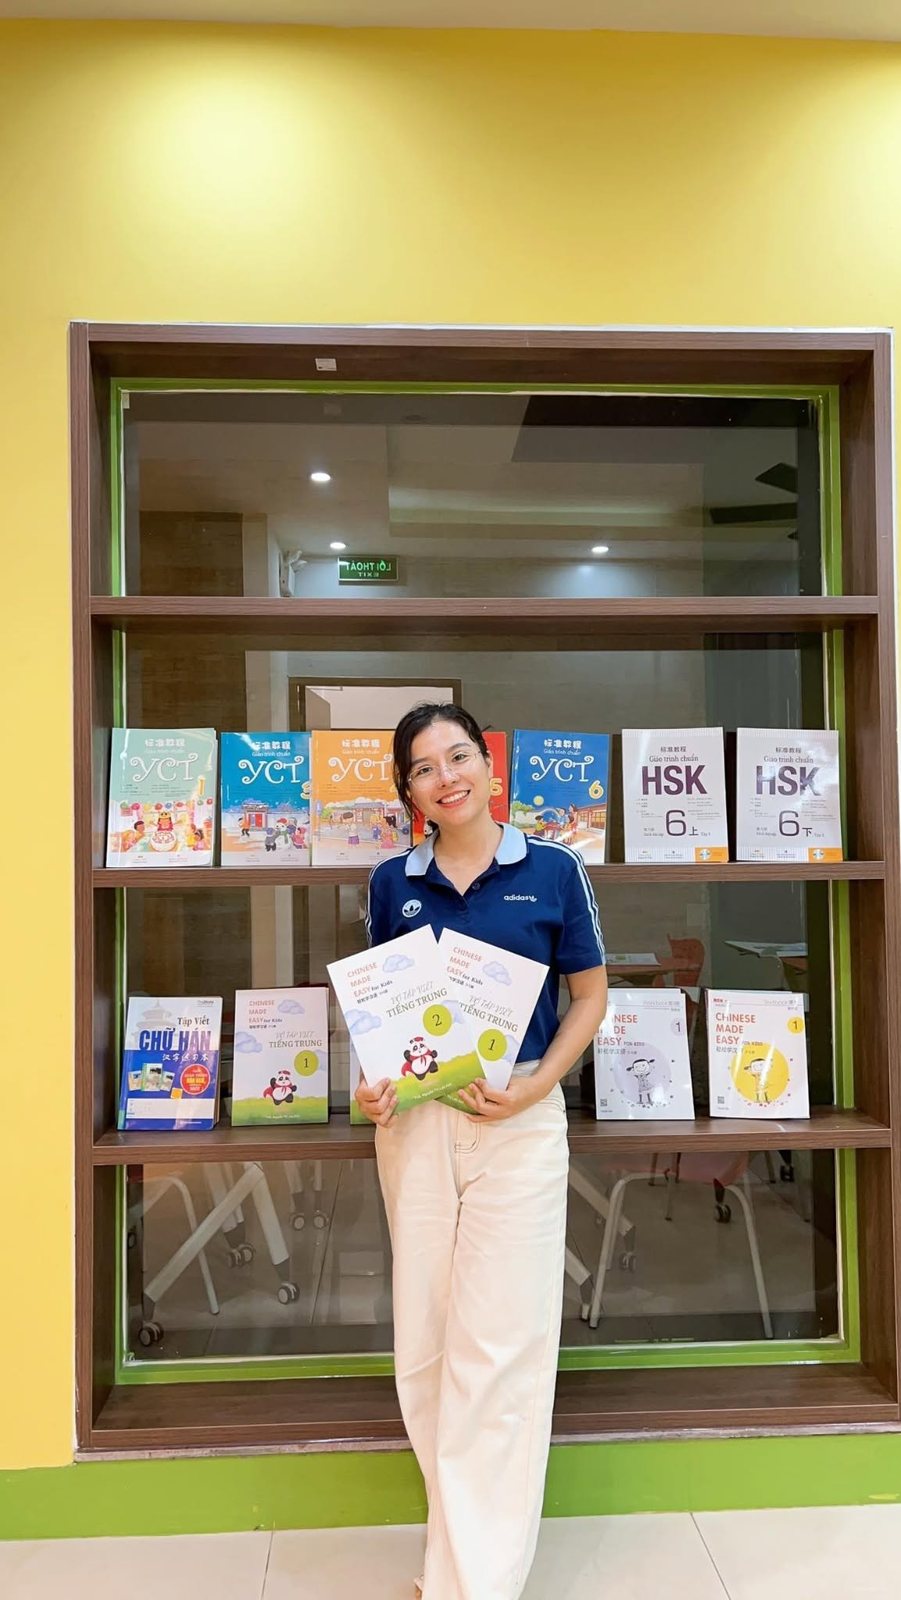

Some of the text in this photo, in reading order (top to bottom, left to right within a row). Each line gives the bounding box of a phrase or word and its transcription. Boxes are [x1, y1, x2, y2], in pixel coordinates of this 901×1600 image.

[129, 752, 198, 782] YCT
[238, 756, 304, 785] YCT
[328, 753, 393, 782] YCT
[529, 755, 595, 782] YCT
[641, 765, 708, 795] HSK
[756, 765, 822, 796] HSK
[489, 777, 503, 797] 5
[588, 780, 604, 799] 6
[666, 809, 687, 836] 6
[779, 810, 800, 836] 6
[688, 826, 699, 836] 上
[802, 827, 813, 837] 下
[453, 946, 482, 962] CHINESE
[449, 956, 471, 969] MADE
[347, 962, 378, 978] CHINESE
[447, 966, 463, 977] EASY
[350, 975, 371, 988] MADE
[353, 986, 372, 998] EASY
[386, 988, 448, 1018] TIẾNG TRUNG
[432, 1013, 443, 1026] 2
[459, 1001, 518, 1033] TIẾNG TRUNG
[715, 1012, 756, 1023] CHINESE
[675, 1021, 681, 1033] 1
[716, 1024, 744, 1034] MADE
[792, 1020, 798, 1030] 1
[139, 1027, 211, 1051] CHỮ HÁN
[269, 1039, 322, 1048] TIẾNG TRUNG
[488, 1038, 496, 1051] 1
[597, 1037, 622, 1046] EASY
[716, 1035, 740, 1045] EASY
[303, 1057, 309, 1068] 1
